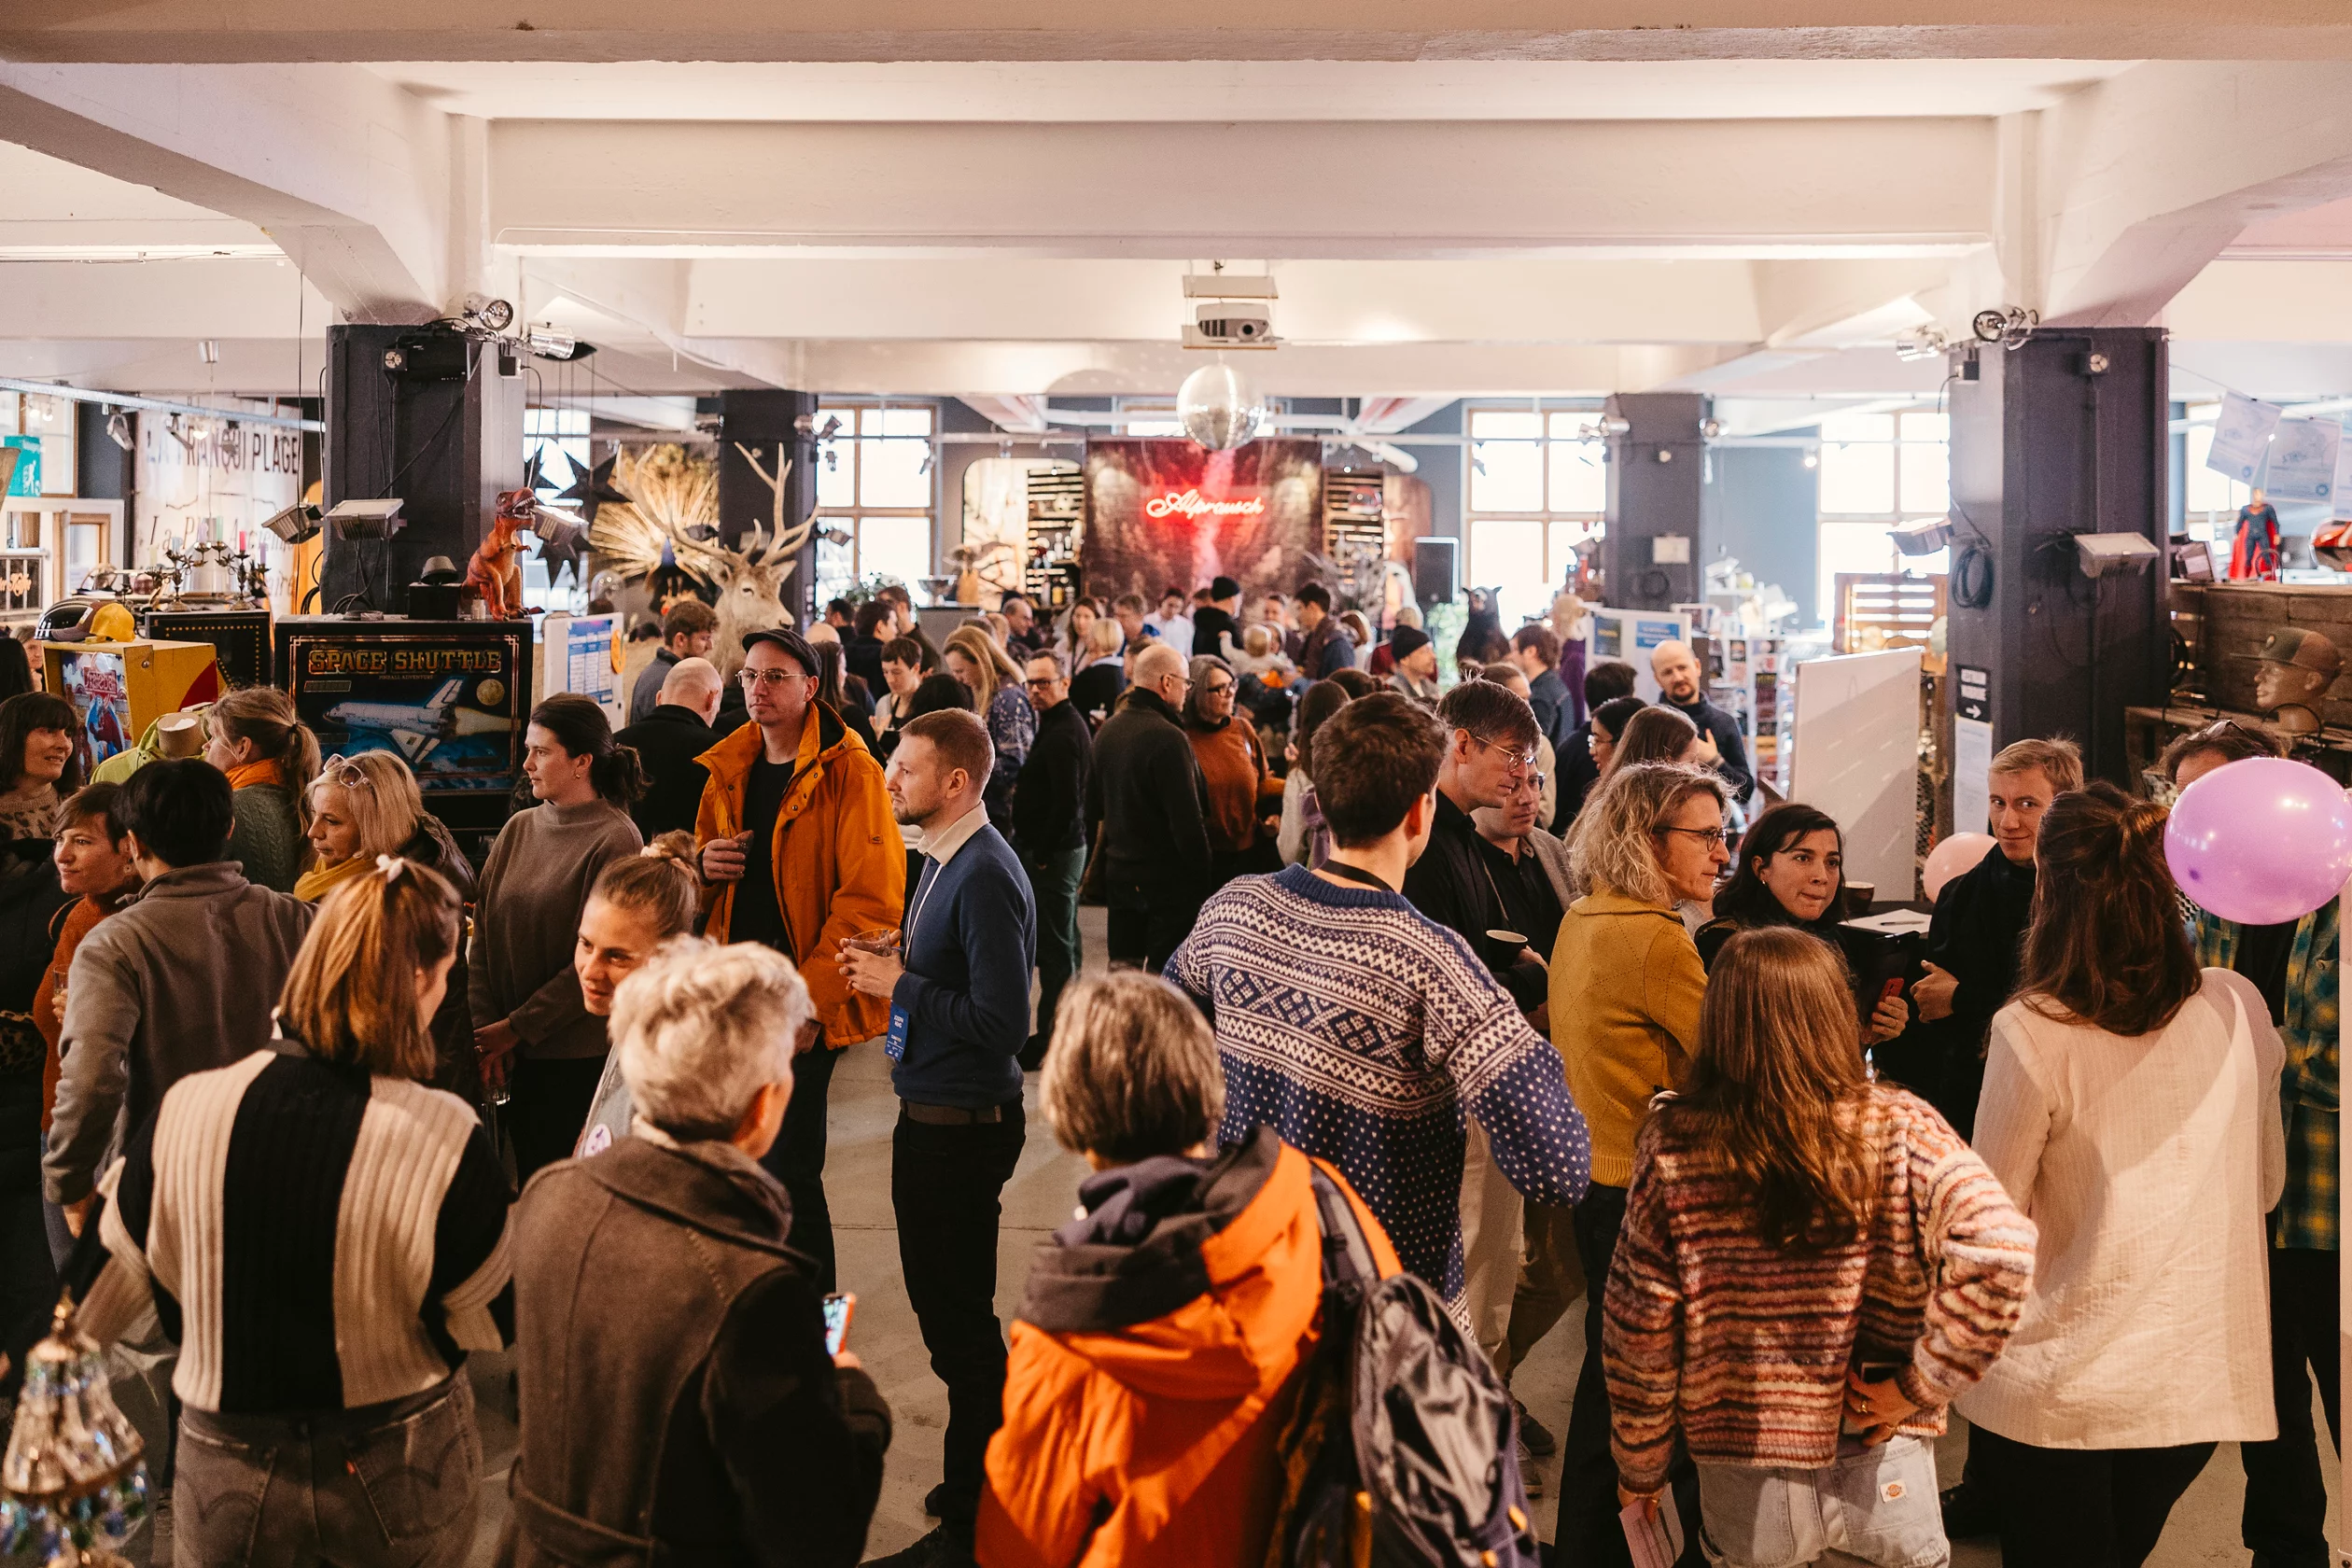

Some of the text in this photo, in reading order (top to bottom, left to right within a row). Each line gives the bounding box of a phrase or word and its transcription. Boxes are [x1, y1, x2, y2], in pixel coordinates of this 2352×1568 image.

[252, 433, 299, 474] PLAGE
[1145, 488, 1266, 520] Alprausch
[310, 651, 500, 673] SPACE SHUTTLE
